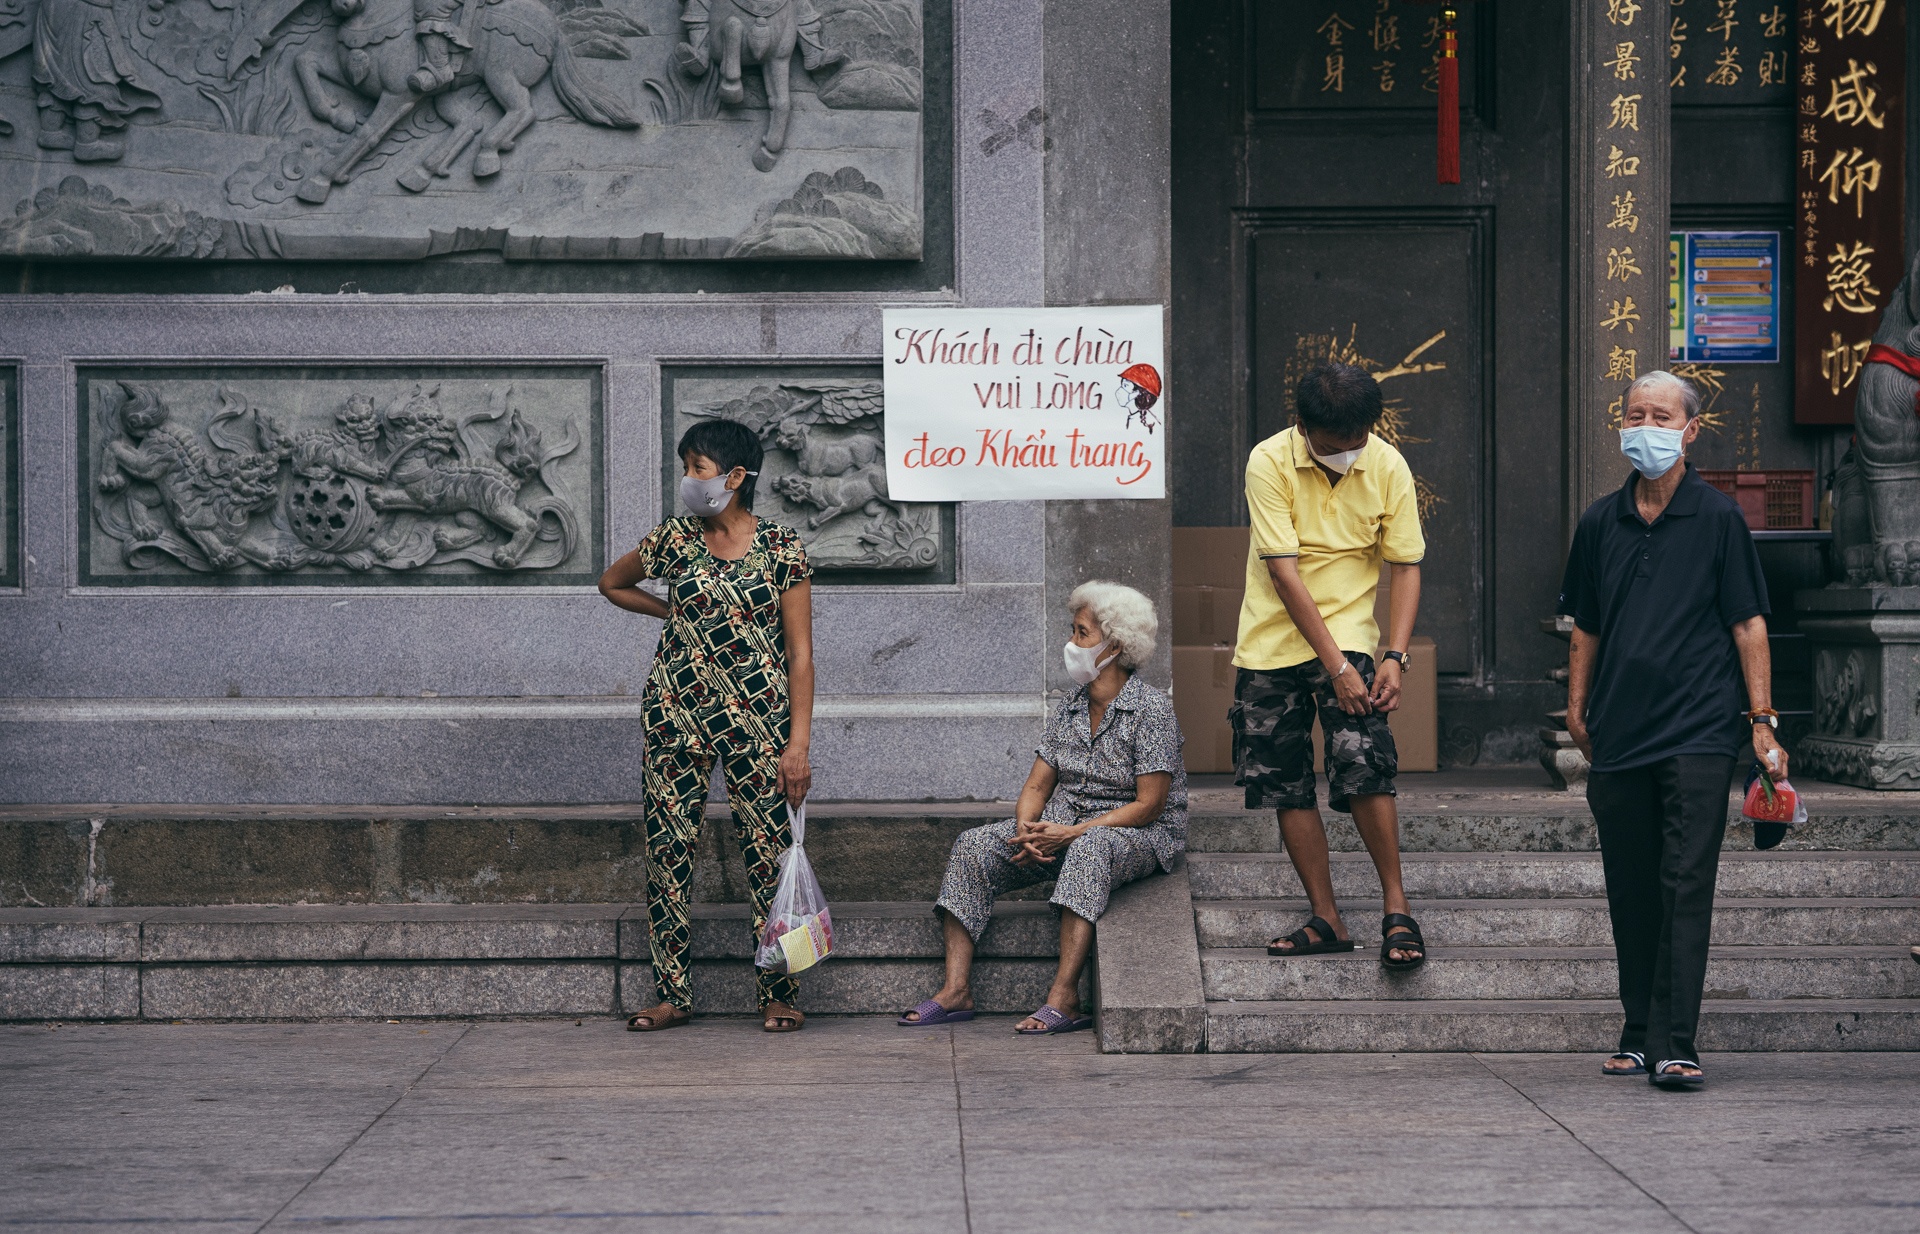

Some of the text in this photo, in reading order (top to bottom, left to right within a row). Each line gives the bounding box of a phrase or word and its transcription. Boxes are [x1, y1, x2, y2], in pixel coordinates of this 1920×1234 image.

[895, 327, 1000, 365] Khách
[1012, 328, 1043, 365] đi
[903, 427, 1152, 485] đeo Khẩu trang
